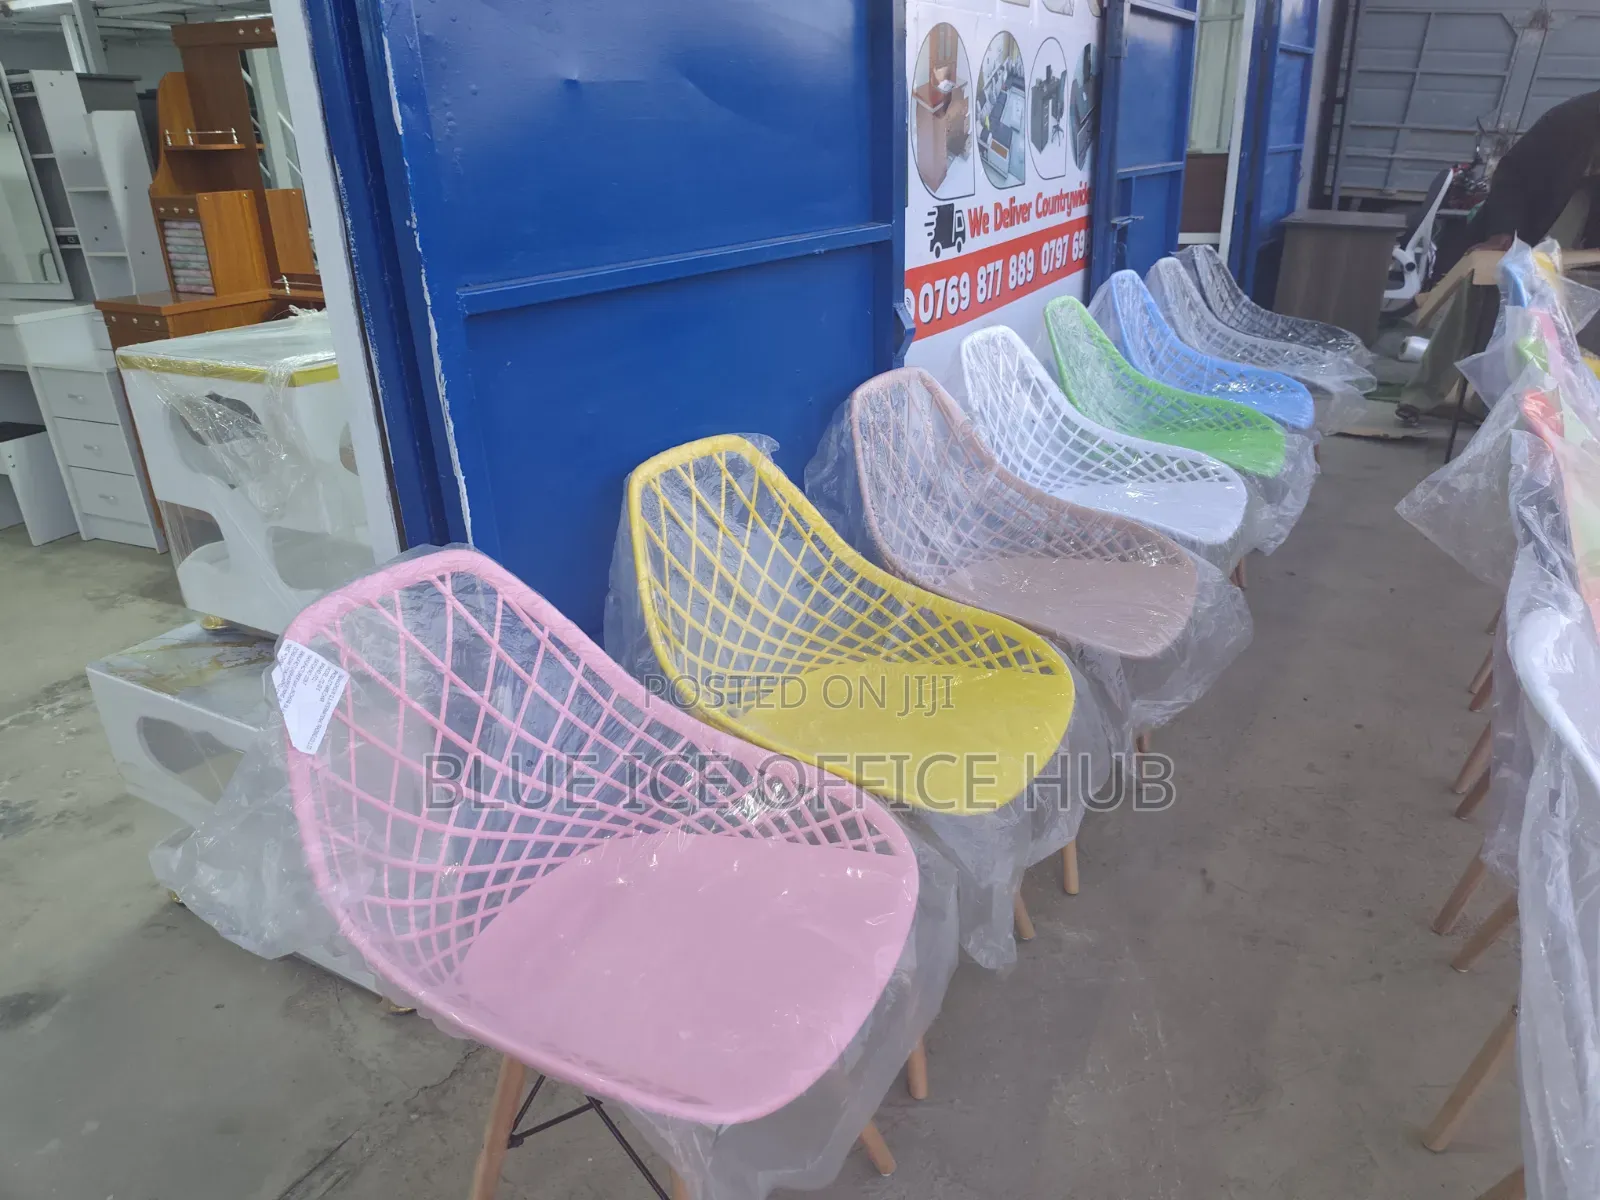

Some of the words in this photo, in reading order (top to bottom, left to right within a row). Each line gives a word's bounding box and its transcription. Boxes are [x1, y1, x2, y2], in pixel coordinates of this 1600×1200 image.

[967, 205, 990, 238] We
[993, 195, 1033, 232] Deliver
[918, 271, 971, 324] 0769
[976, 258, 1004, 304] 877
[1008, 248, 1035, 290] 889
[1040, 234, 1070, 275] 0797
